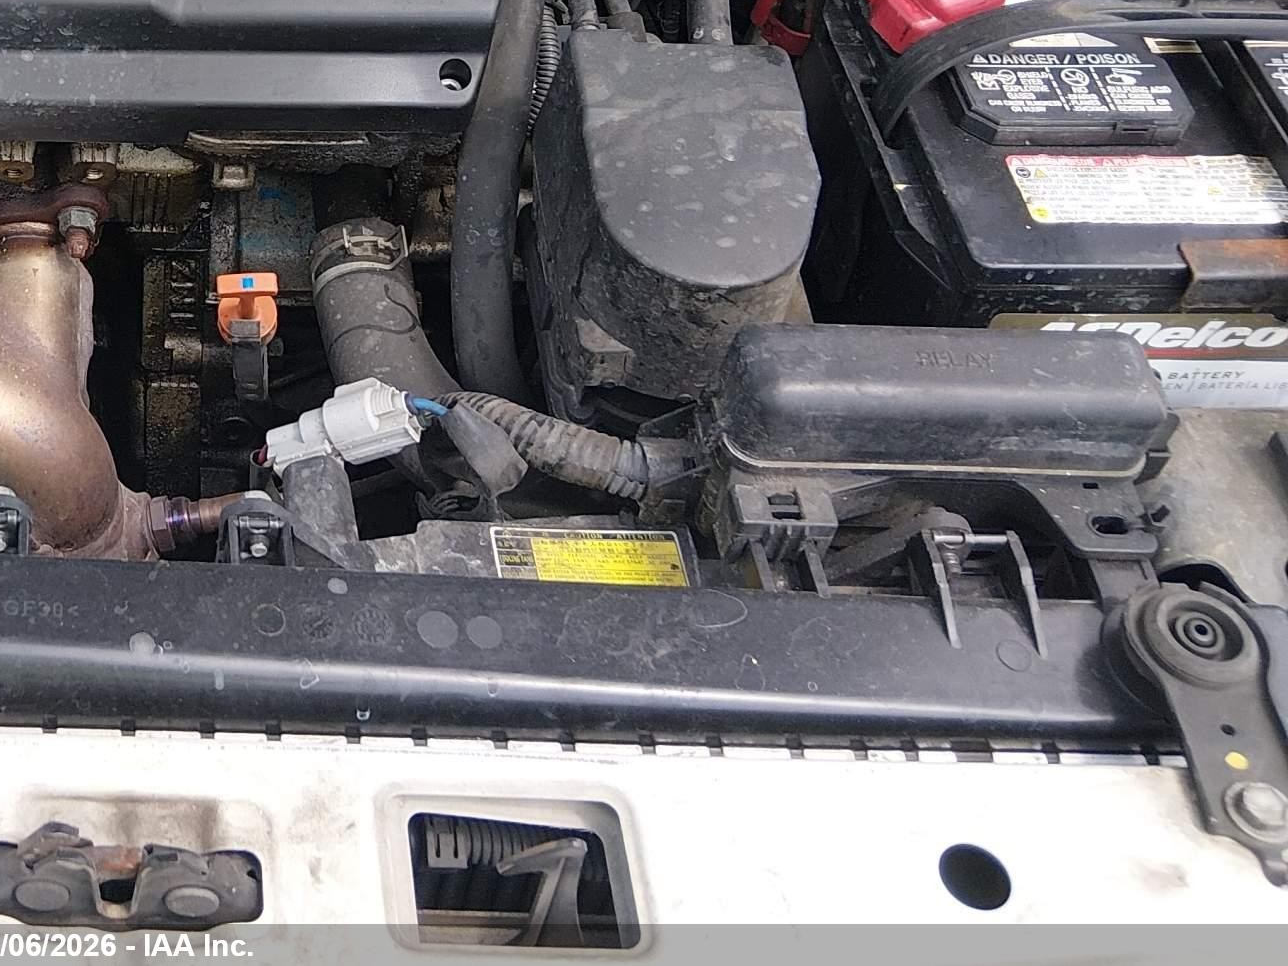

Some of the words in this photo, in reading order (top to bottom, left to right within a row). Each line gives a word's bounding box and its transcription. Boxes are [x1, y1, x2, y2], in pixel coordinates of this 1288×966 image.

[988, 53, 1060, 65] DANGER
[1075, 53, 1142, 65] POISON
[915, 349, 994, 369] RELAY
[1168, 370, 1246, 380] BATTERY
